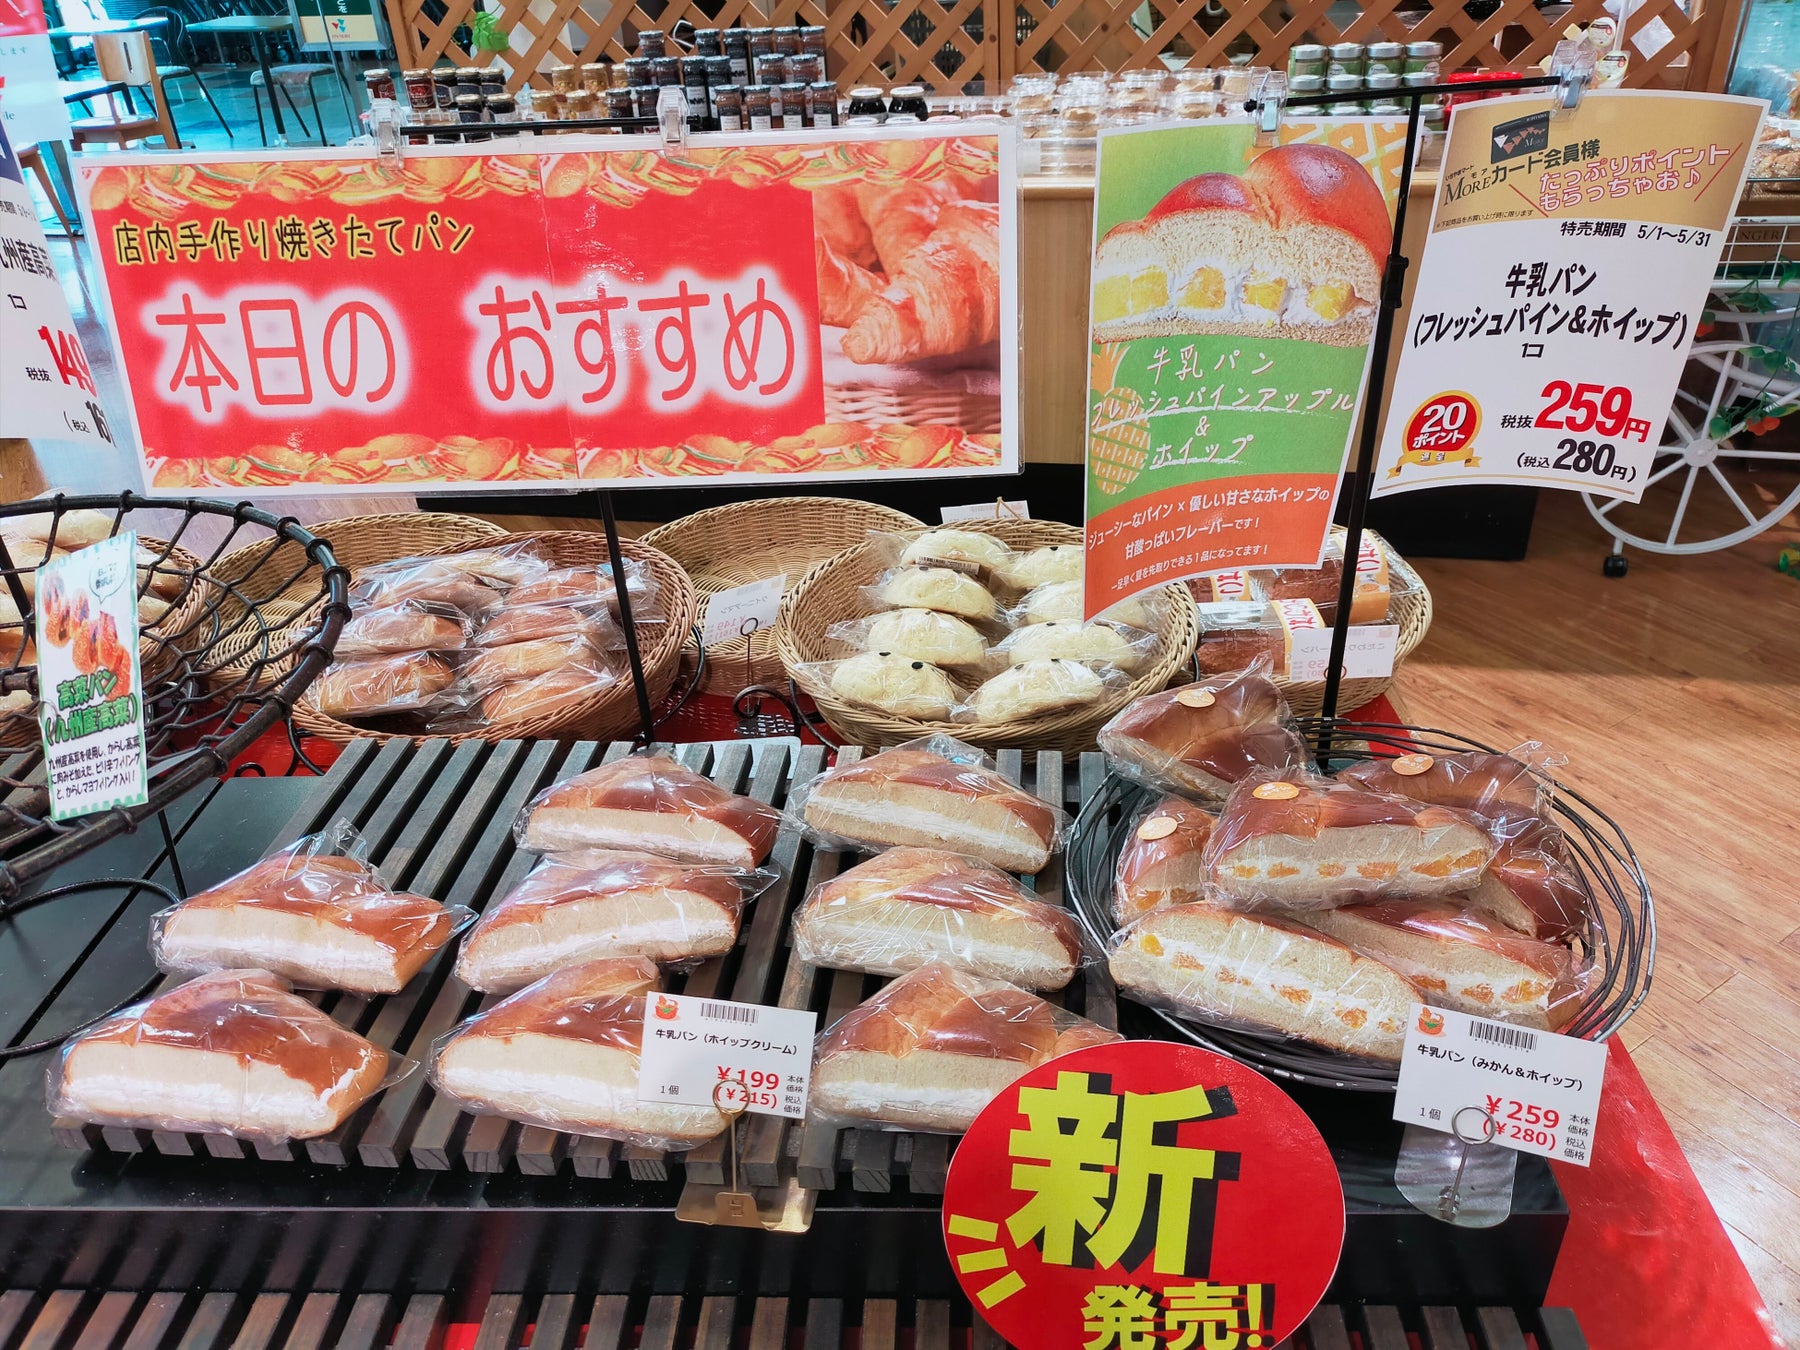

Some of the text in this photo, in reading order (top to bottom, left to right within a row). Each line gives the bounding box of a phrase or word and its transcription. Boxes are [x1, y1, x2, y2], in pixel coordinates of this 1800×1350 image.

[1540, 144, 1730, 193] たっぷりポイント
[114, 213, 474, 264] 店内手作り焼きたてパン
[1560, 221, 1627, 238] 特売期間
[1504, 261, 1597, 298] 牛乳パン
[155, 277, 796, 414] 本日の おすすめ
[1147, 344, 1274, 384] 牛乳パン
[1195, 415, 1211, 437] &
[1420, 401, 1468, 434] 20
[1153, 434, 1255, 466] ホイップ
[1412, 430, 1466, 449] ポイント
[57, 669, 117, 711] 高菜パン
[1005, 1070, 1218, 1278] 新
